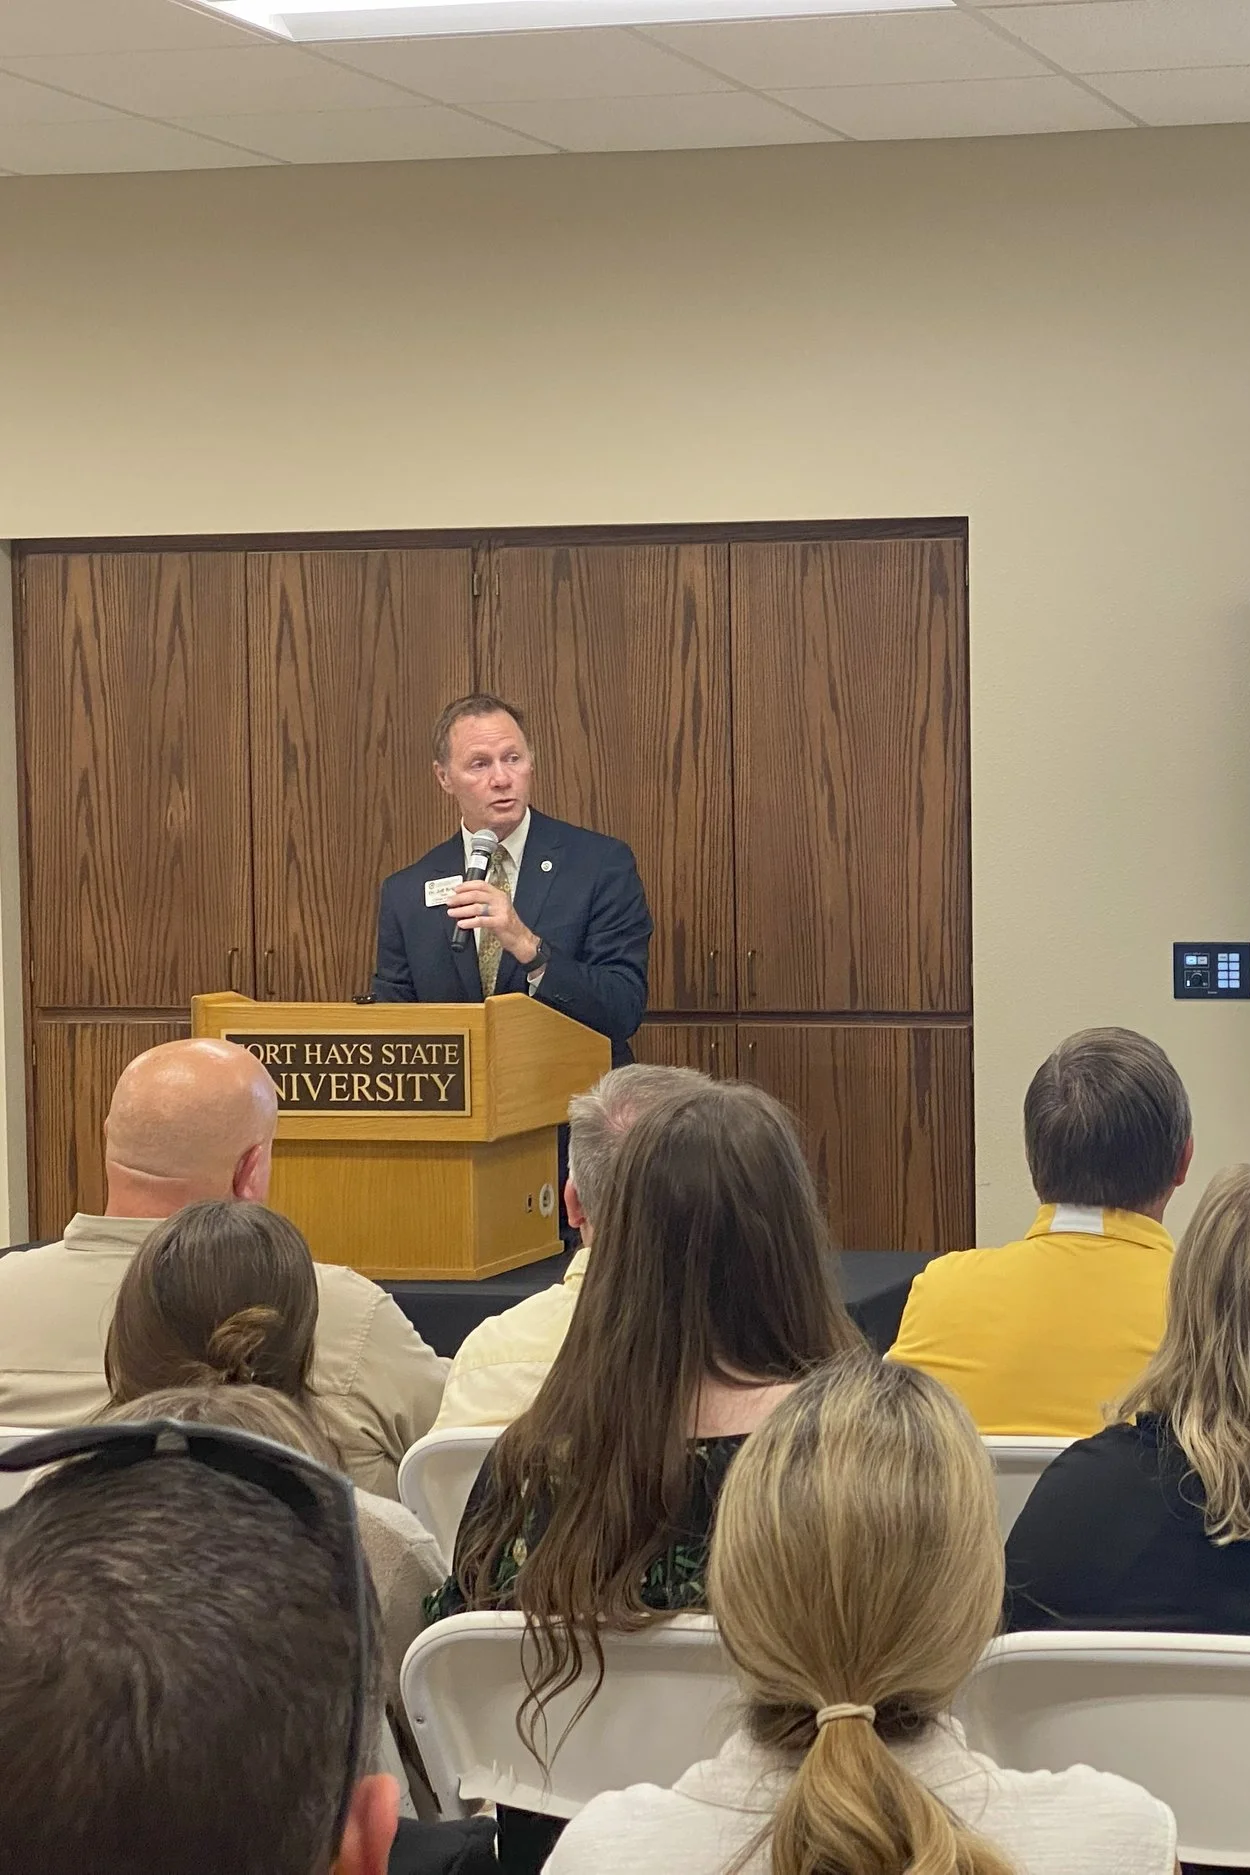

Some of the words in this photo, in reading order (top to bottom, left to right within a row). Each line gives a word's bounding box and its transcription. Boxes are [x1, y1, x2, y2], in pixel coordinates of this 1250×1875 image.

[241, 1043, 297, 1065] ORT
[304, 1043, 373, 1065] HAYS
[381, 1043, 460, 1065] STATE
[273, 1073, 457, 1101] NIVERSITY
